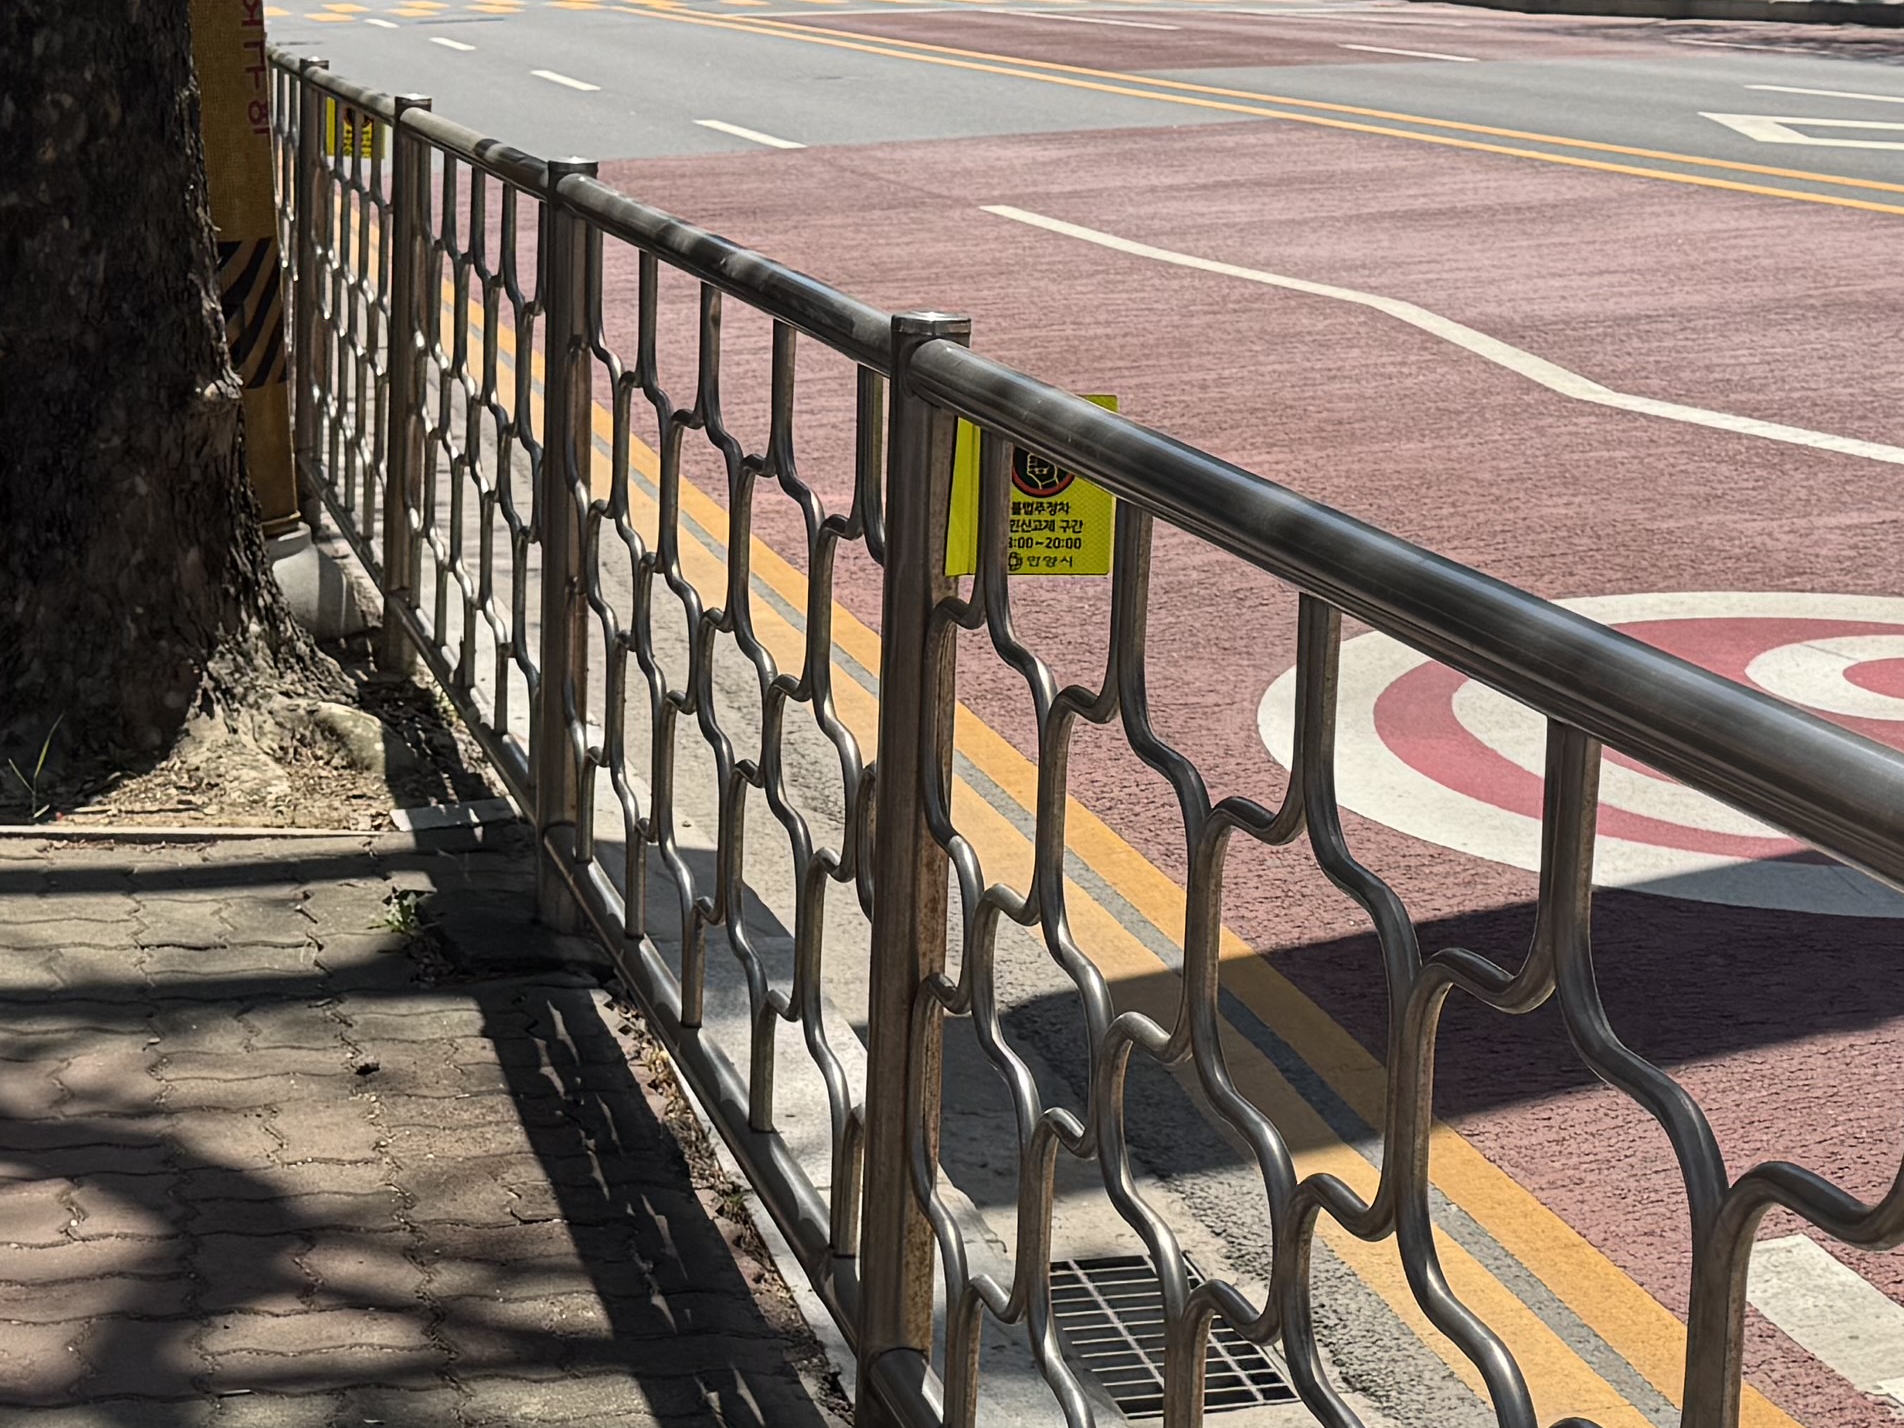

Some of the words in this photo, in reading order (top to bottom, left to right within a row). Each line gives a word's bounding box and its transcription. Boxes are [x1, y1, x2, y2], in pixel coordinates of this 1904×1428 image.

[1012, 501, 1070, 516] 불법주정차
[1059, 519, 1083, 533] 구간
[1027, 555, 1073, 568] 안양시
